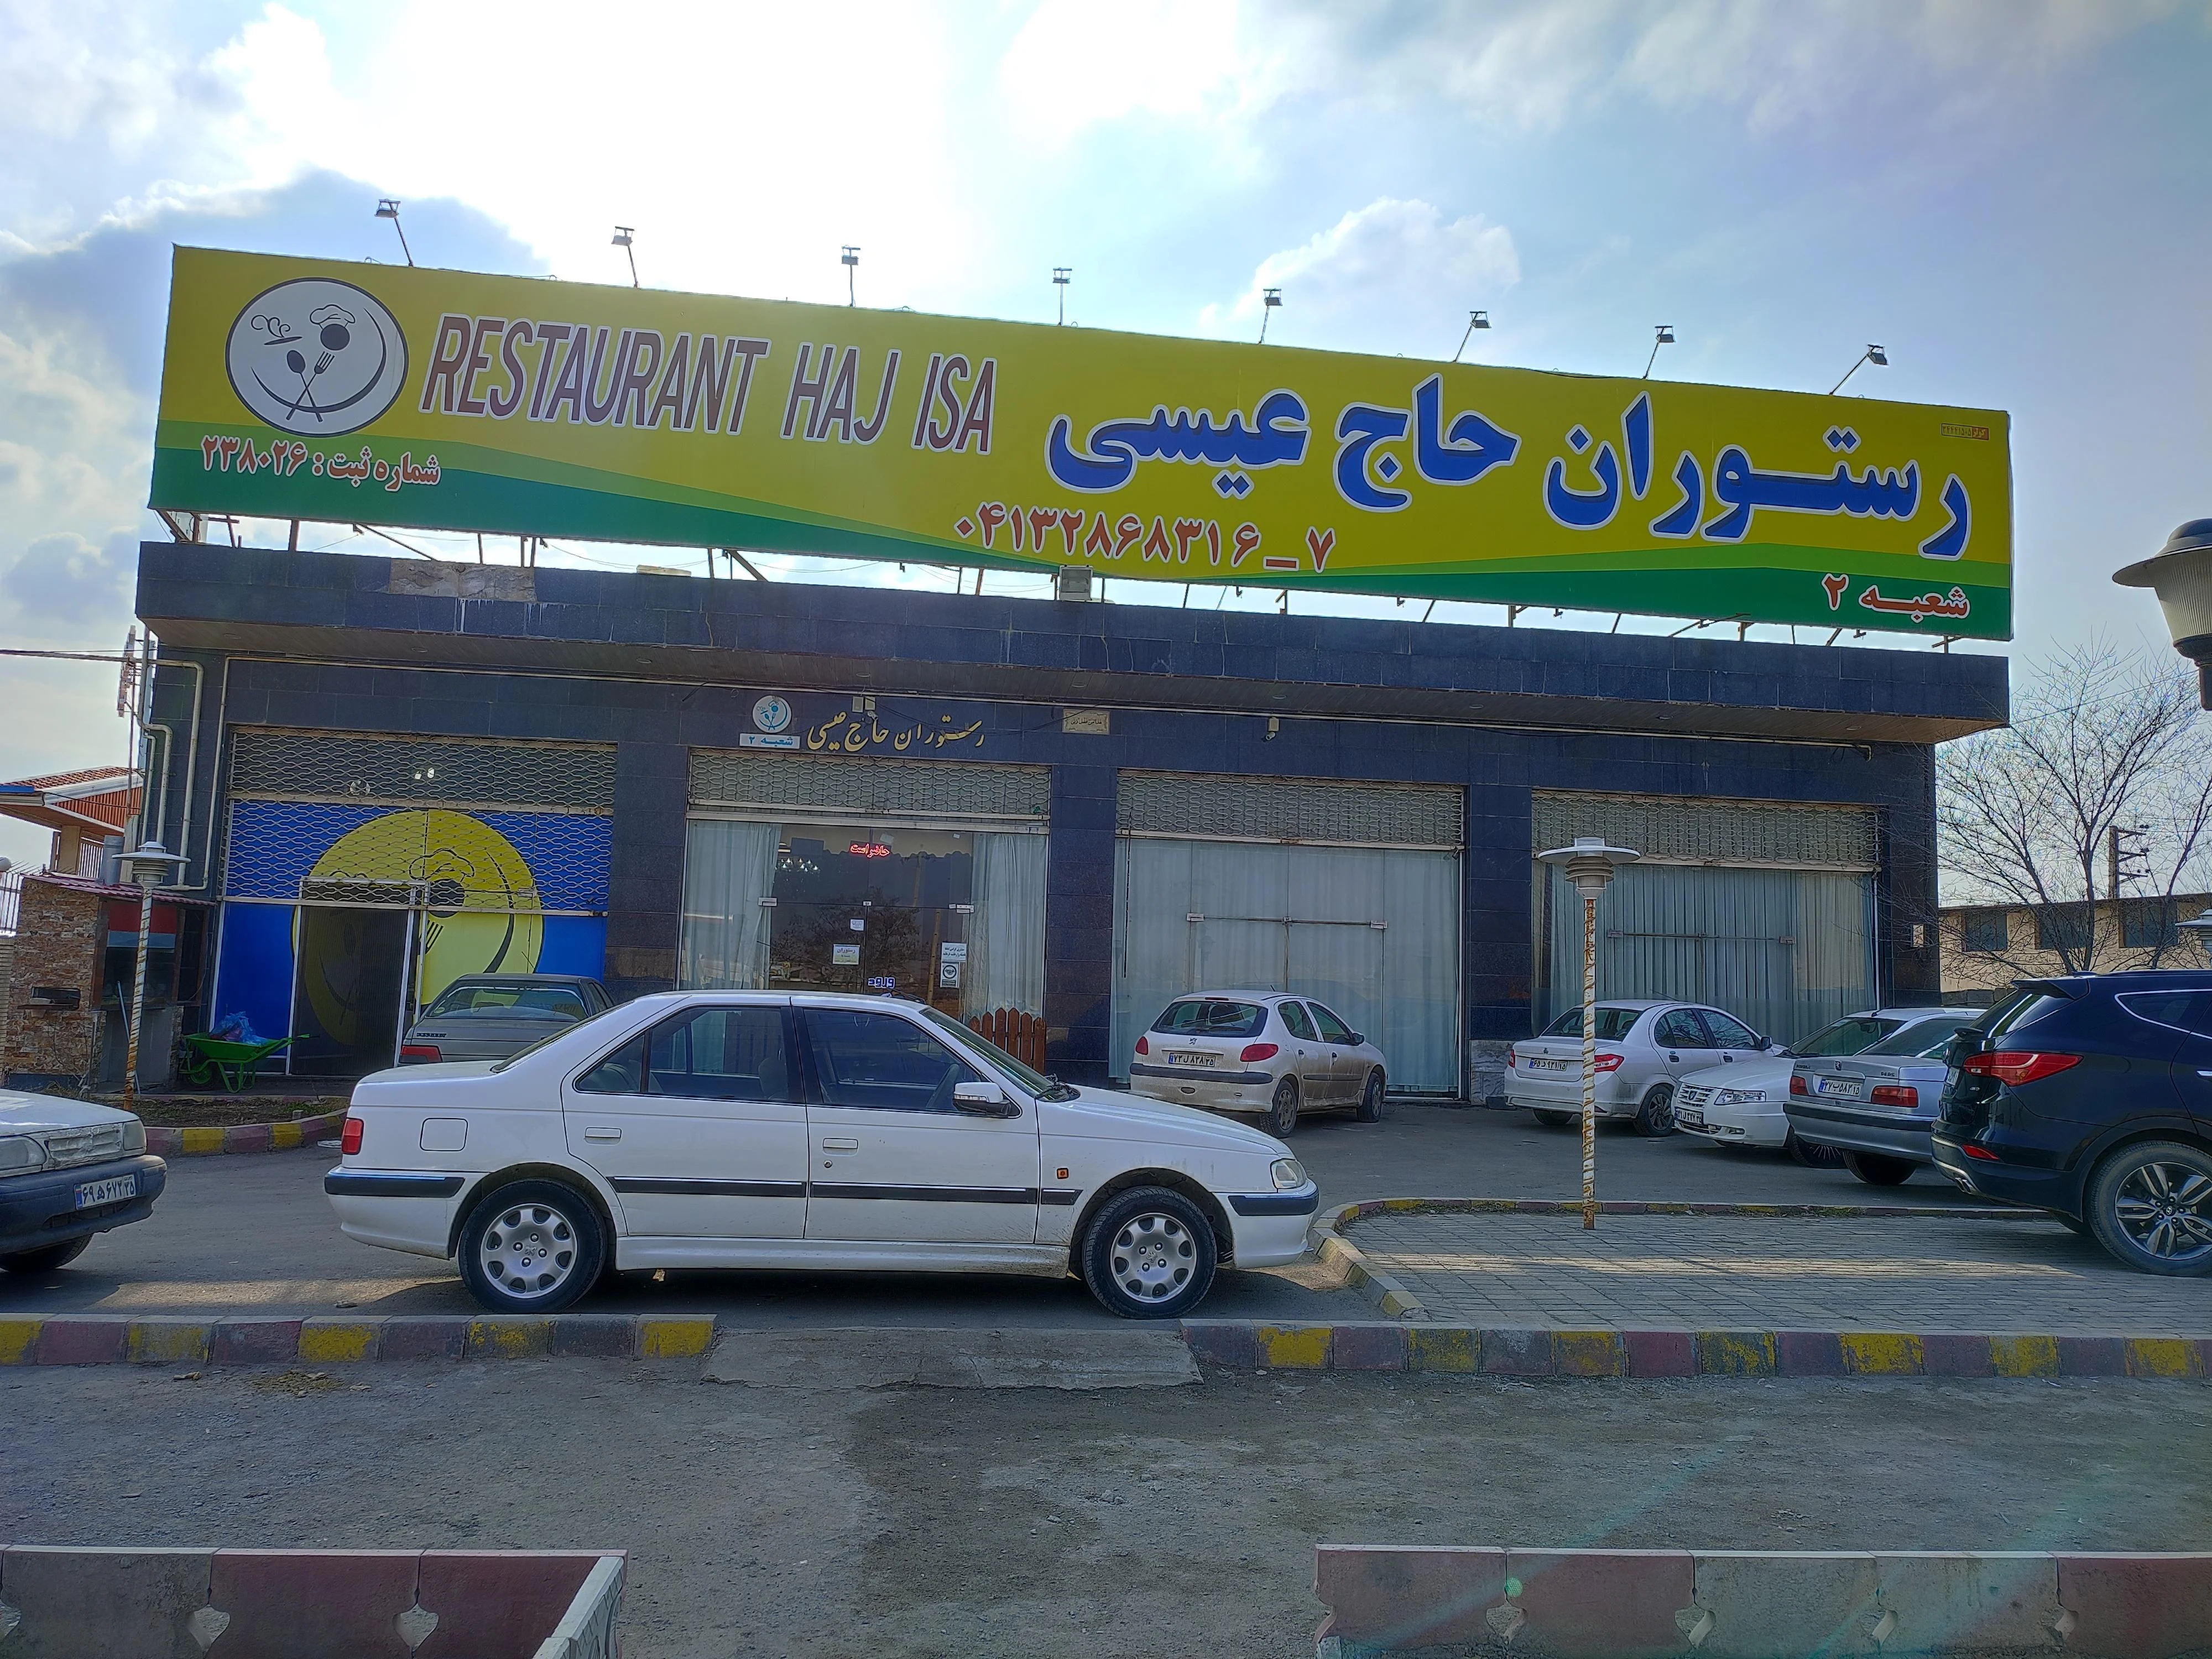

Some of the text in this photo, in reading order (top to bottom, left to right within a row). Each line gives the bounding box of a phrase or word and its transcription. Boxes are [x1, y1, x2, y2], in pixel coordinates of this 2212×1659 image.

[419, 313, 997, 455] RESTAURANT HAJ ISA
[201, 435, 309, 476] ۲۳۸۰۲۶
[373, 452, 441, 492] شماره
[1045, 373, 1971, 560] رستوران حاج عیسی
[1822, 573, 1970, 623] شعبه ۲
[749, 736, 794, 747] شعبه ۲
[844, 718, 889, 752] حاج
[894, 714, 985, 750] رستوران
[868, 977, 895, 989] ورود
